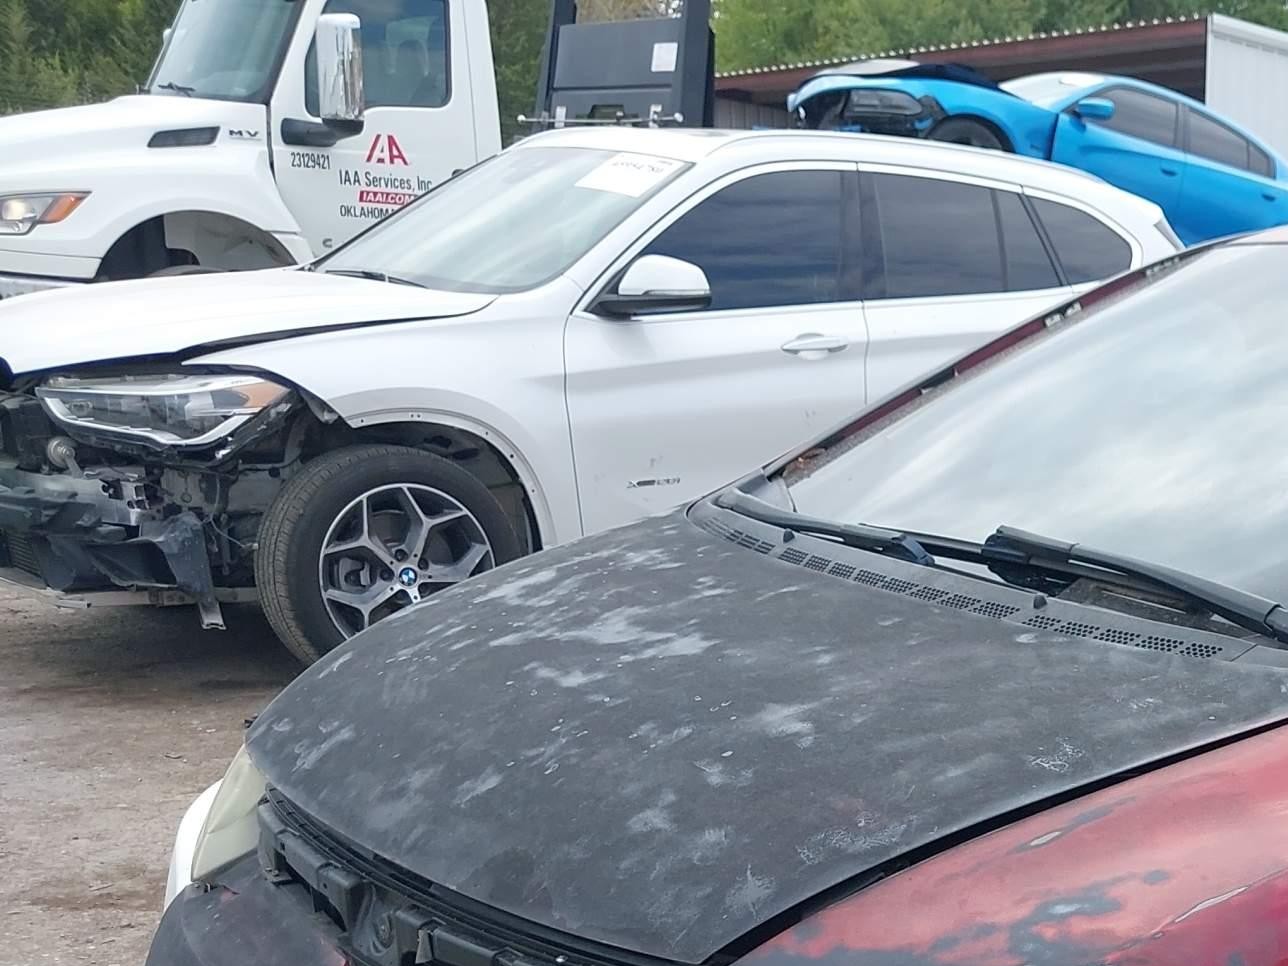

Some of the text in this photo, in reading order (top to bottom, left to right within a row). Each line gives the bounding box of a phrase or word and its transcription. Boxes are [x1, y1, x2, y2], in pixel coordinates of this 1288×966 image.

[228, 129, 260, 138] MV
[290, 151, 331, 170] 23129421
[339, 169, 361, 187] IAA
[364, 171, 415, 193] Services,
[339, 204, 395, 219] OKLAHOM
